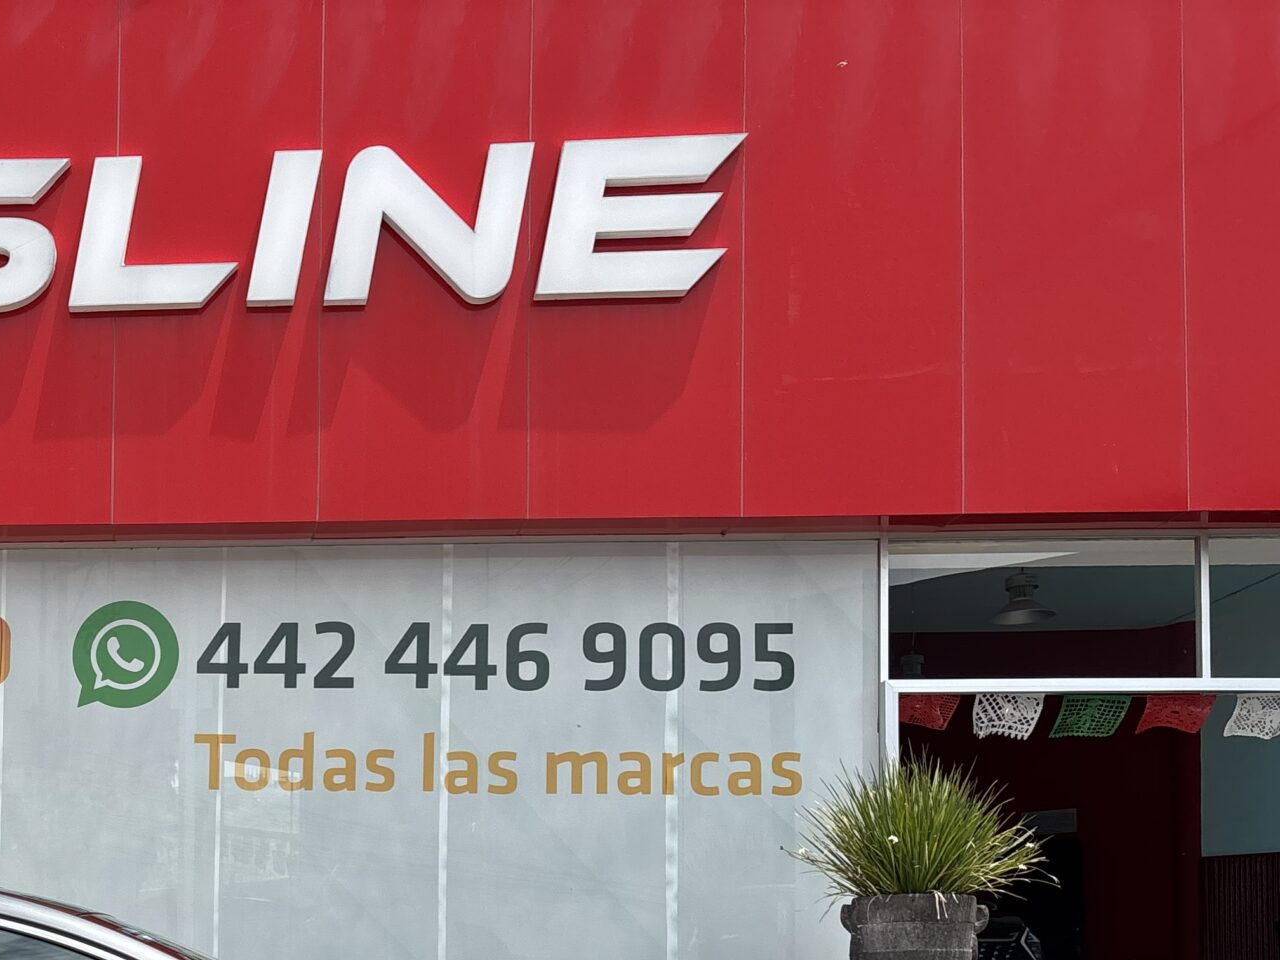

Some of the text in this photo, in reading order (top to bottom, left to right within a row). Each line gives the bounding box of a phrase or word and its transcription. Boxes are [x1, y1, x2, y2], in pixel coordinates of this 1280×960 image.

[196, 621, 795, 692] 442 446 9095
[194, 731, 803, 796] Todas las marcas
